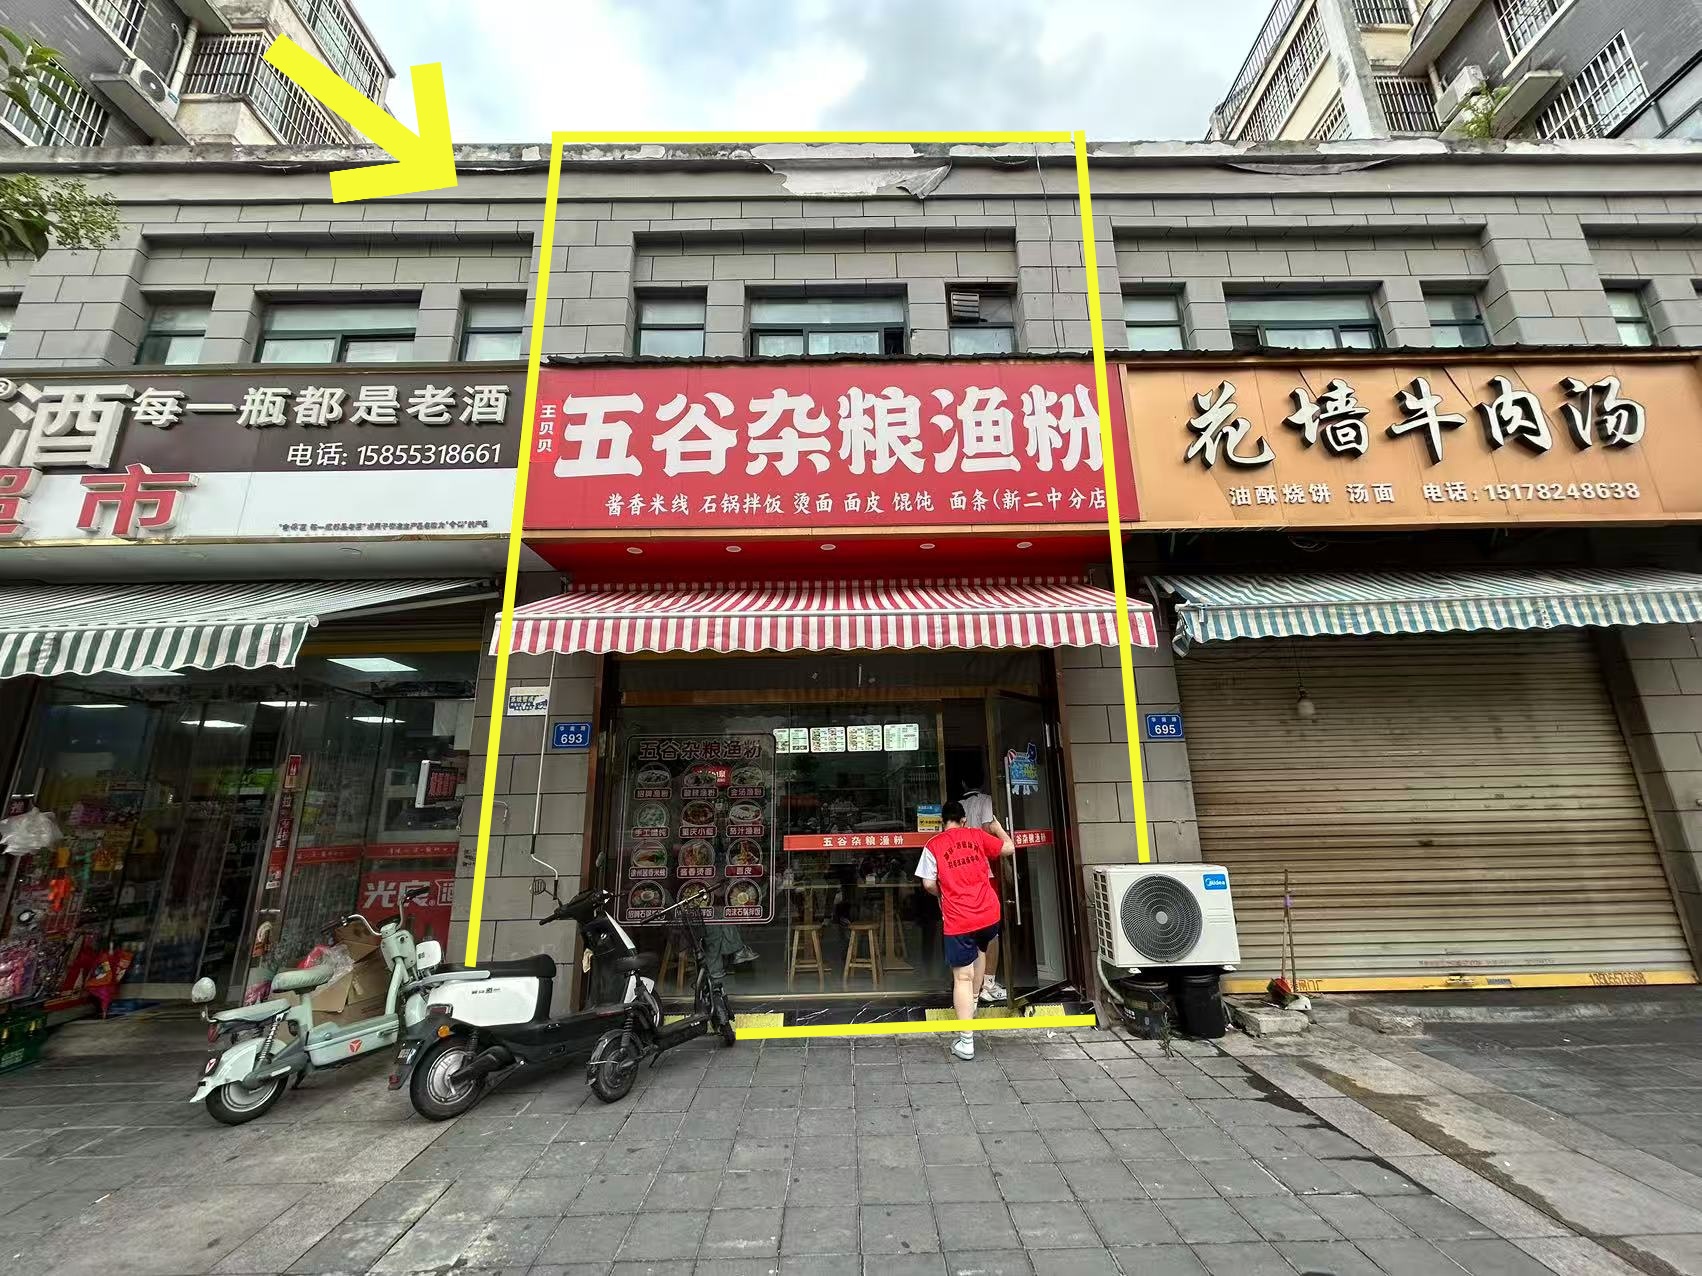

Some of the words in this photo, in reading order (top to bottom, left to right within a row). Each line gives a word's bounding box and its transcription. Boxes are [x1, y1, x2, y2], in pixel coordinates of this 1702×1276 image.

[131, 384, 507, 428] 每一瓶都是老酒
[539, 403, 557, 455] 王贝贝
[553, 383, 1105, 478] 五谷杂粮渔粉
[1184, 374, 1646, 470] 花墙牛肉汤
[357, 442, 502, 464] 15855318661
[606, 492, 690, 517] 酱香米线
[699, 490, 783, 516] 石锅拌饭
[792, 491, 834, 515] 烫面
[843, 491, 884, 515] 面皮
[891, 490, 934, 514] 馄饨
[1230, 484, 1331, 507] 油酥烧饼
[1346, 483, 1394, 505] 汤面
[1484, 480, 1640, 503] 15178248638
[561, 733, 583, 744] 693
[1154, 724, 1176, 735] 695
[638, 740, 762, 760] 五谷杂粮渔粉
[823, 836, 904, 847] 五谷杂粮渔粉
[736, 867, 753, 875] 面皮
